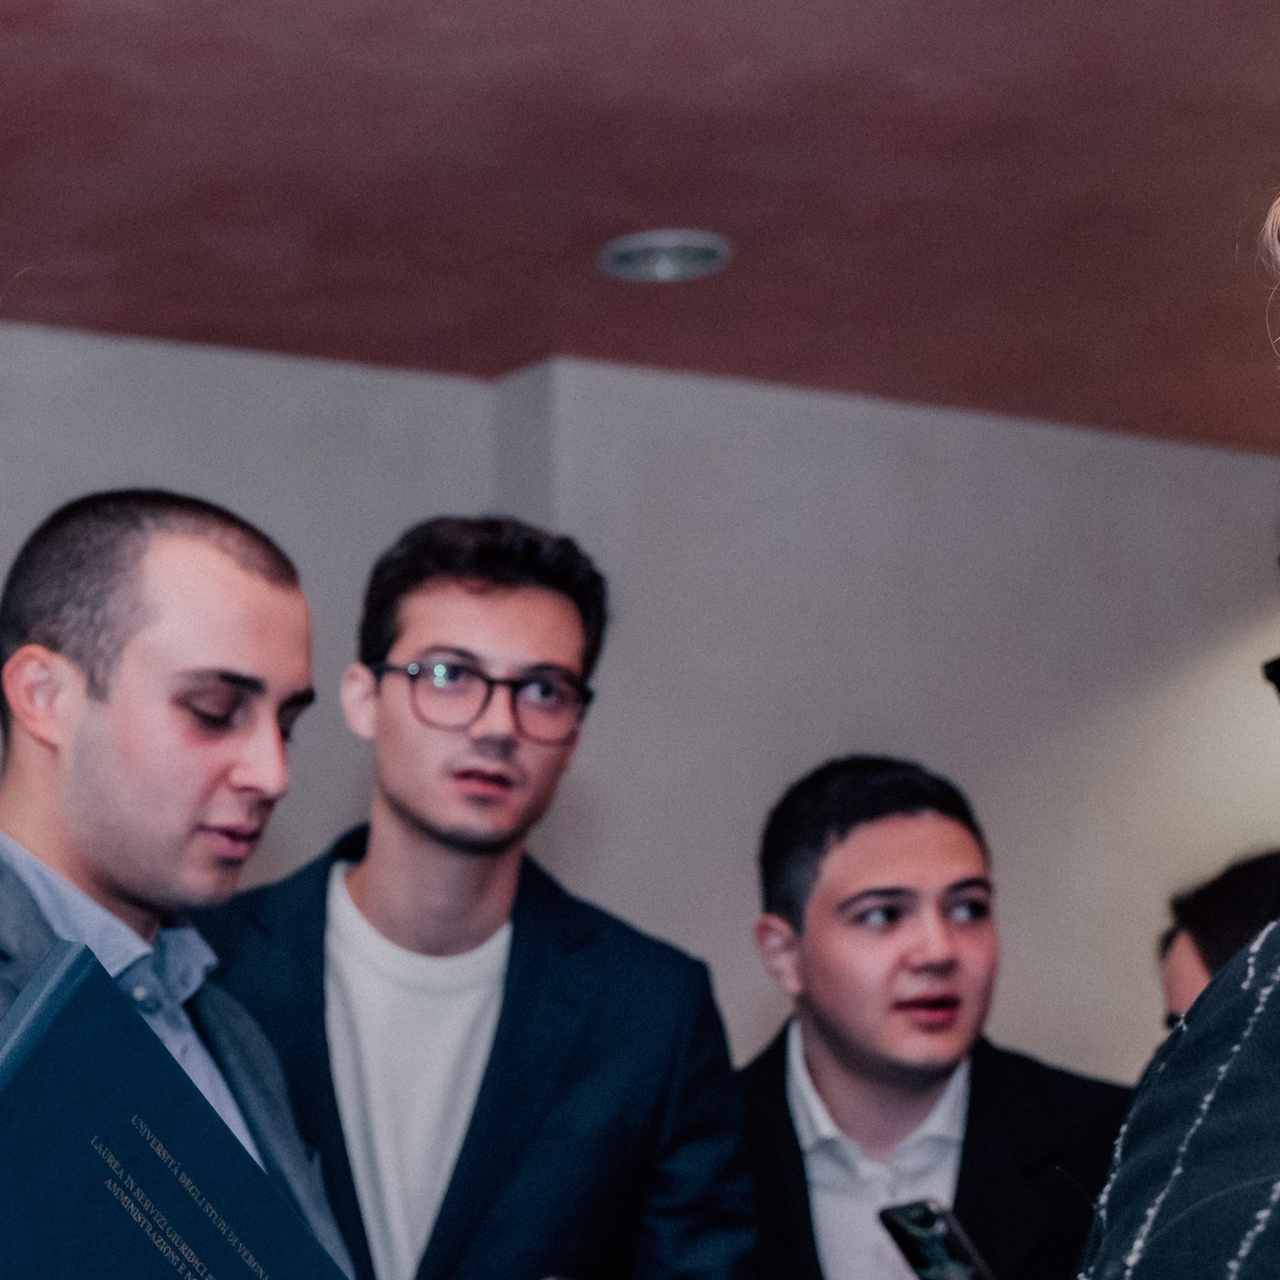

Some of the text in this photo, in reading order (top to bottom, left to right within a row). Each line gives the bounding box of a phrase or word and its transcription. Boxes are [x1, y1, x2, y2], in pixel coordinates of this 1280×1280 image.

[88, 1135, 128, 1179] LAUREA
[121, 1174, 137, 1191] IN
[131, 1186, 170, 1230] SERVIZI
[163, 1225, 208, 1276] GIURIDICI
[103, 1176, 181, 1266] AMMINISTRAZIONI
[175, 1262, 188, 1275] E
[175, 1171, 208, 1207] DEGLI
[224, 1230, 240, 1247] DI
